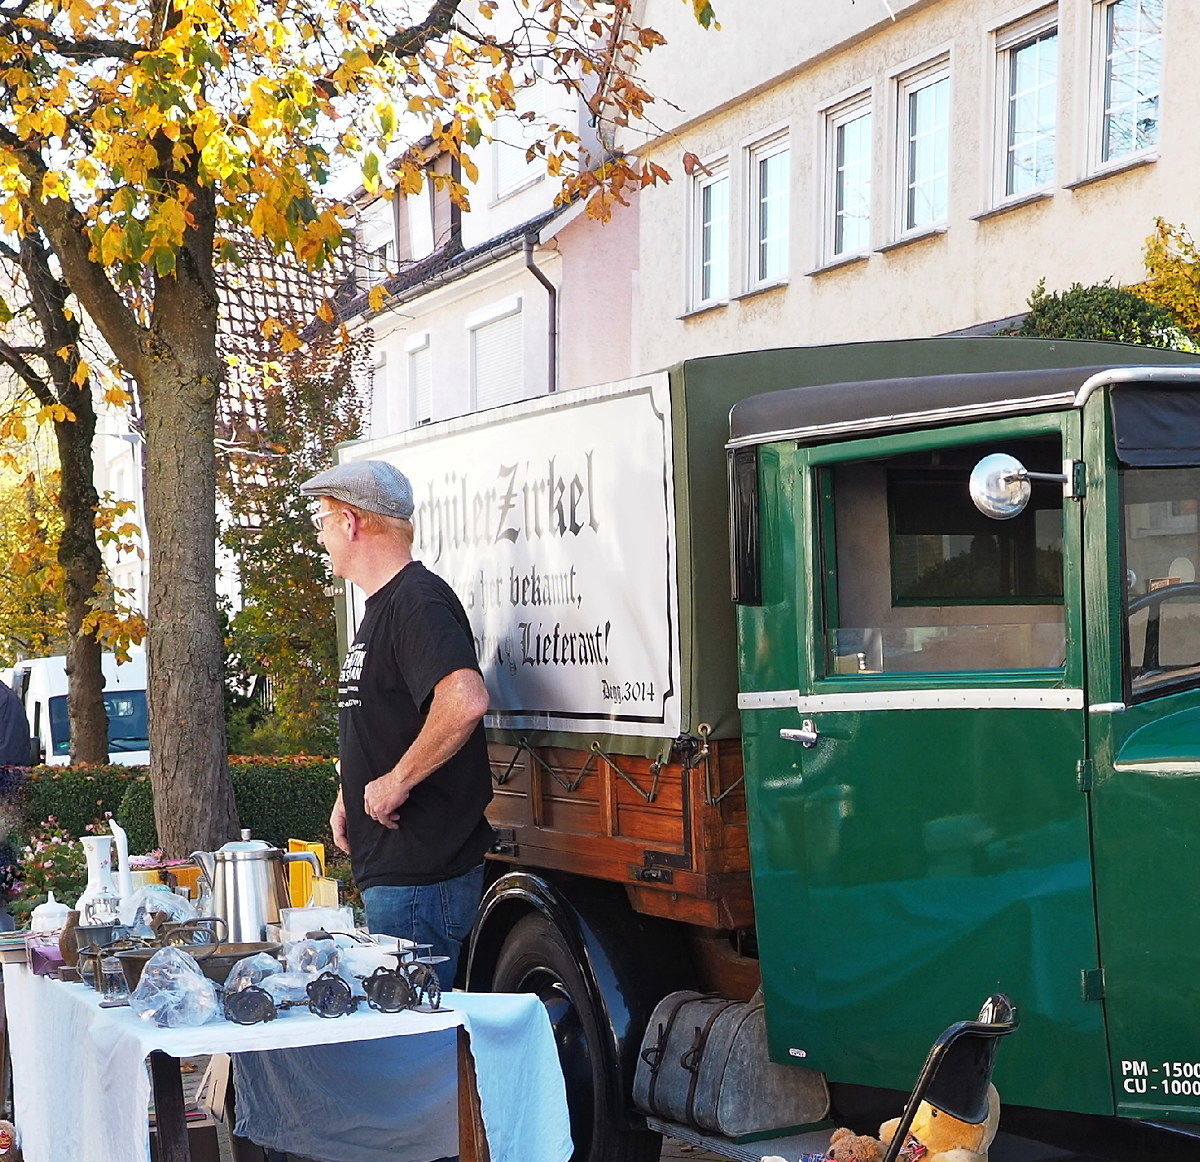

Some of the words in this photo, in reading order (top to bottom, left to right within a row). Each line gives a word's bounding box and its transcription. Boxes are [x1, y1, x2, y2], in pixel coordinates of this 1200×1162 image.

[518, 618, 611, 667] Lieferant!
[1121, 1060, 1149, 1077] PM
[1123, 1078, 1147, 1094] CU
